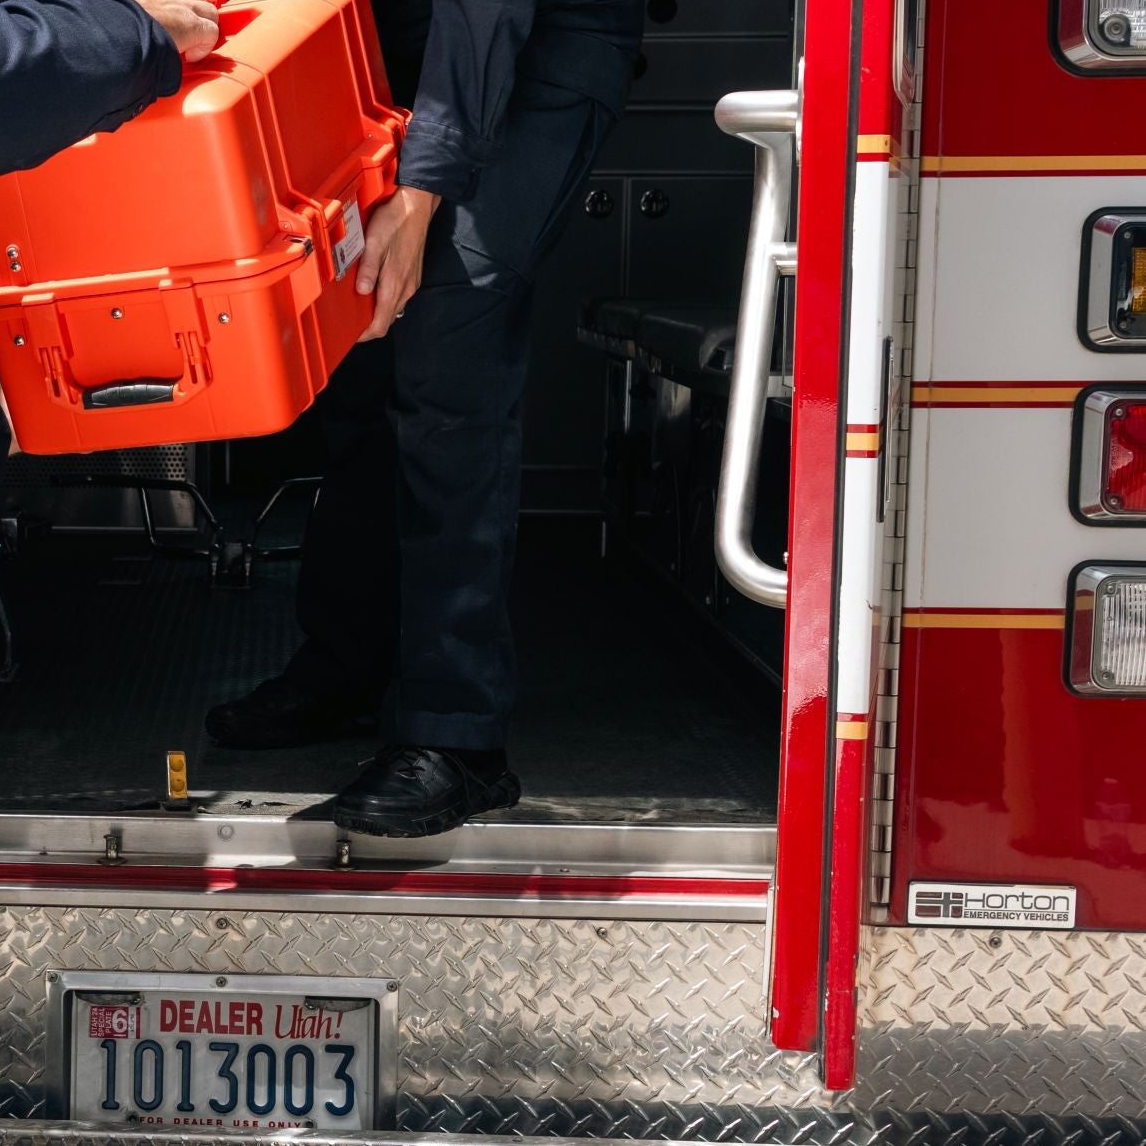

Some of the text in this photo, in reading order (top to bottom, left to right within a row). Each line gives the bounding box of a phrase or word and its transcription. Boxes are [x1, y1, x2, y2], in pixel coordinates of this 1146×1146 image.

[964, 891, 1070, 911] Horton
[963, 911, 1069, 922] EMERGENCY VEHICLES
[112, 1009, 128, 1034] 6
[160, 999, 263, 1036] DEALER
[275, 1004, 344, 1040] Utah!
[100, 1038, 356, 1117] 1013003
[139, 1116, 302, 1129] FOR DEALER USE ONLY
